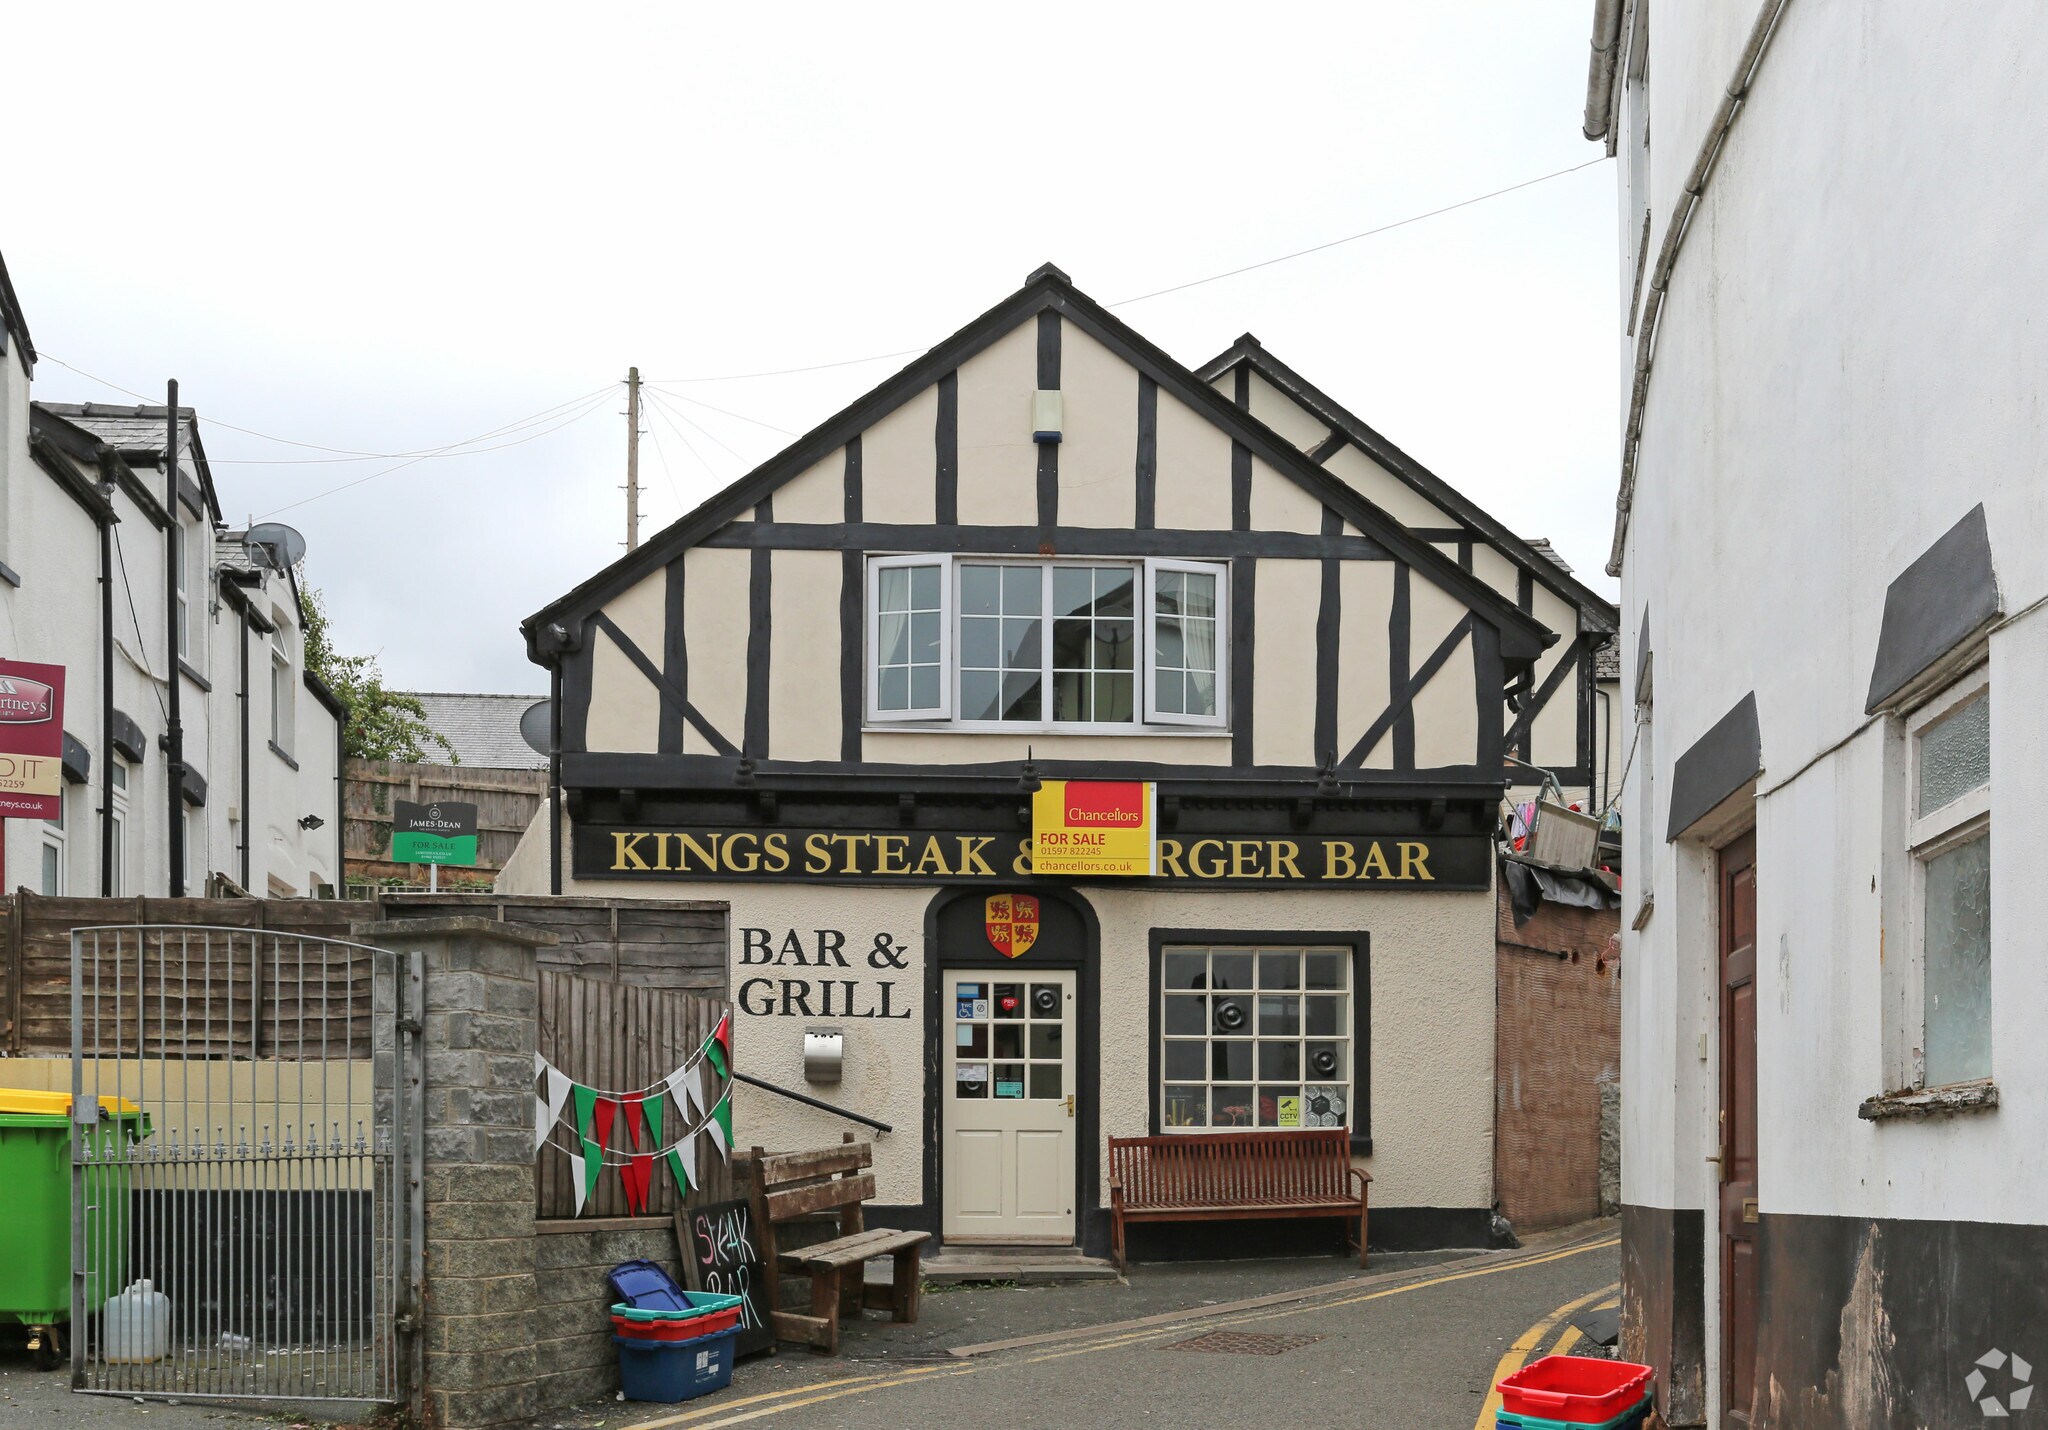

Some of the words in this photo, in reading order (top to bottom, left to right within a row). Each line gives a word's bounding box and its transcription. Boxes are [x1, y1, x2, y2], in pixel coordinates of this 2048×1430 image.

[0, 698, 47, 715] rtneys
[23, 759, 44, 779] IT
[0, 800, 43, 811] neys.co.uk
[1068, 808, 1139, 822] Chancellors
[412, 840, 430, 849] FOR
[432, 842, 456, 850] SALE
[1040, 833, 1068, 846] FOR
[1072, 833, 1106, 846] SALE
[610, 832, 790, 872] KINGS
[805, 833, 997, 876] STEAK
[1156, 839, 1305, 879] RGER
[1321, 841, 1435, 881] BAR
[1040, 847, 1067, 856] 01597
[1069, 847, 1101, 856] 822245
[1040, 860, 1132, 872] chancellors.co.uk
[739, 927, 851, 967] BAR
[867, 932, 909, 969] &
[738, 977, 911, 1019] GRILL
[1280, 1112, 1298, 1120] CCTV
